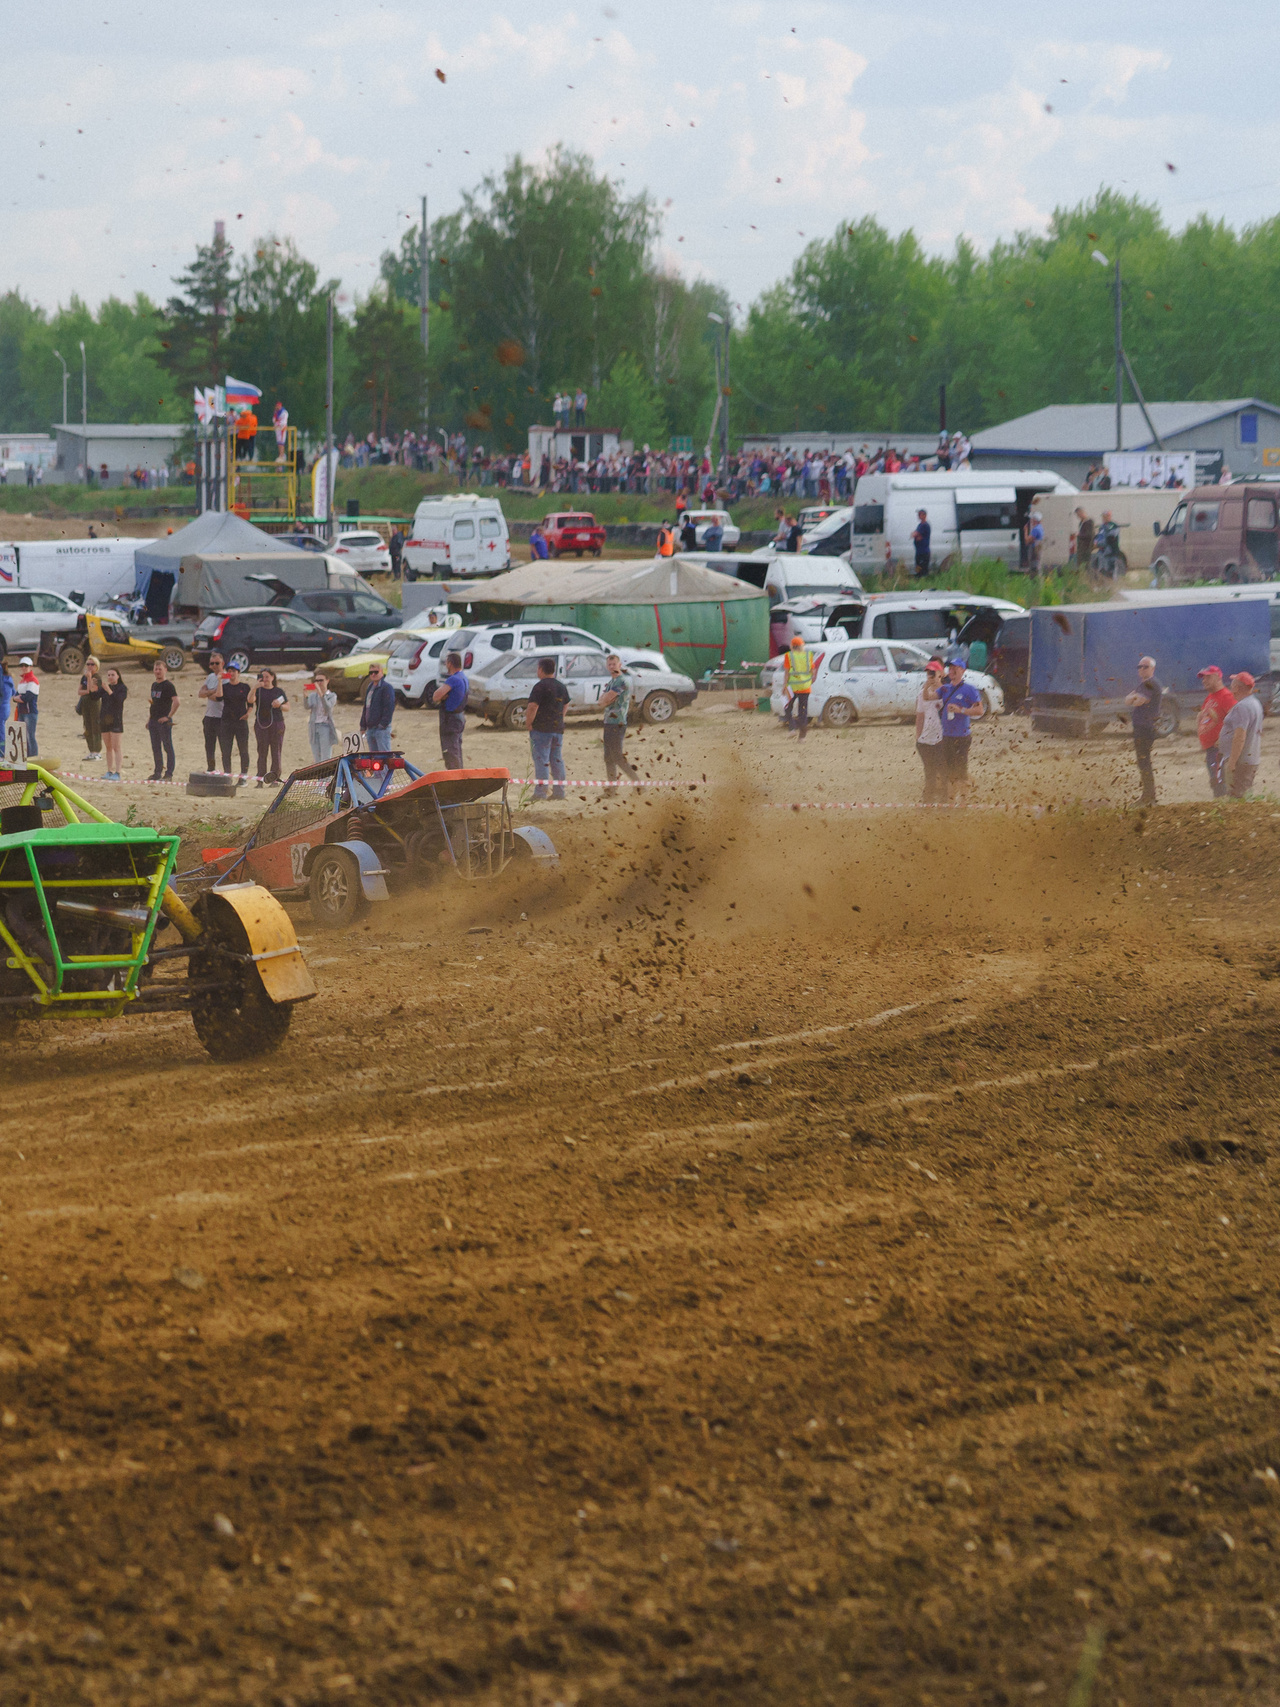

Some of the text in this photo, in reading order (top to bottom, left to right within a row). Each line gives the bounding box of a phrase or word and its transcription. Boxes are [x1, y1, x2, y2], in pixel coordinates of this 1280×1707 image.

[56, 546, 111, 555] autocross
[525, 638, 532, 649] 7
[8, 725, 25, 763] 31
[343, 733, 361, 755] 29
